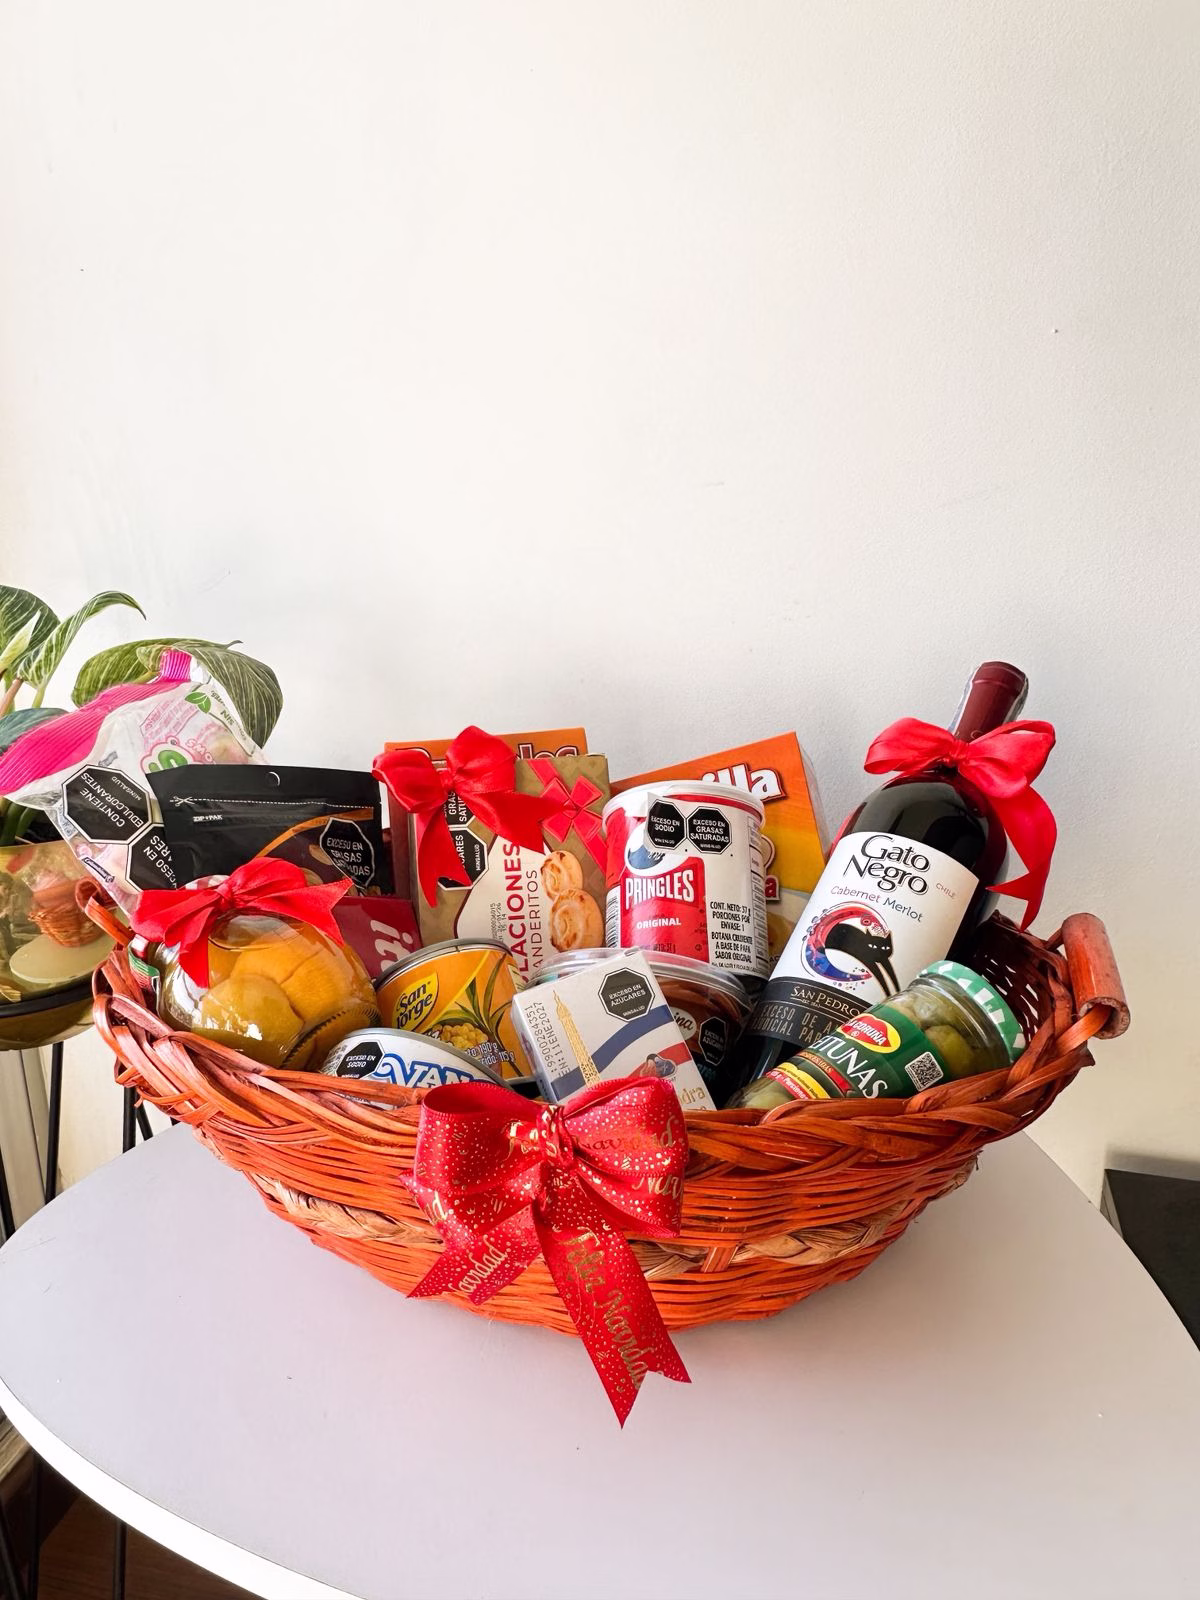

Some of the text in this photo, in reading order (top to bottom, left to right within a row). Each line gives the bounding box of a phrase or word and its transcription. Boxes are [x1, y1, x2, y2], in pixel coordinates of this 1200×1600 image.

[81, 772, 144, 828] EDULCORANTES
[80, 787, 126, 827] CONTIENE
[654, 823, 675, 833] SODIO
[671, 819, 681, 827] EN
[692, 819, 716, 828] EXCESO
[695, 826, 724, 835] GRASAS
[690, 832, 730, 844] SATURADAS
[352, 841, 364, 851] EN
[143, 846, 158, 861] EN
[860, 834, 930, 873] Gato
[842, 854, 929, 896] Negro
[625, 868, 695, 908] PRINGLES
[935, 881, 957, 900] CHILE
[709, 901, 726, 911] CONT.
[830, 885, 924, 923] Cabernet Merlot
[503, 843, 529, 983] LACIONES
[712, 911, 740, 922] PORCIONES
[636, 917, 682, 930] ORIGINAL
[720, 920, 741, 931] ENVASE:
[711, 931, 732, 941] BOTANA
[715, 941, 720, 950] A
[720, 941, 733, 951] BASE
[733, 942, 740, 952] DE
[715, 950, 732, 960] SABOR
[399, 982, 427, 1011] San
[608, 983, 642, 1000] EXCESO EN
[790, 986, 816, 1000] SAN
[817, 992, 861, 1018] PEDRO
[802, 1012, 819, 1029] DE
[345, 1054, 377, 1063] EXCESO EN
[346, 1061, 368, 1069] SODIO
[593, 1288, 656, 1392] Navida
